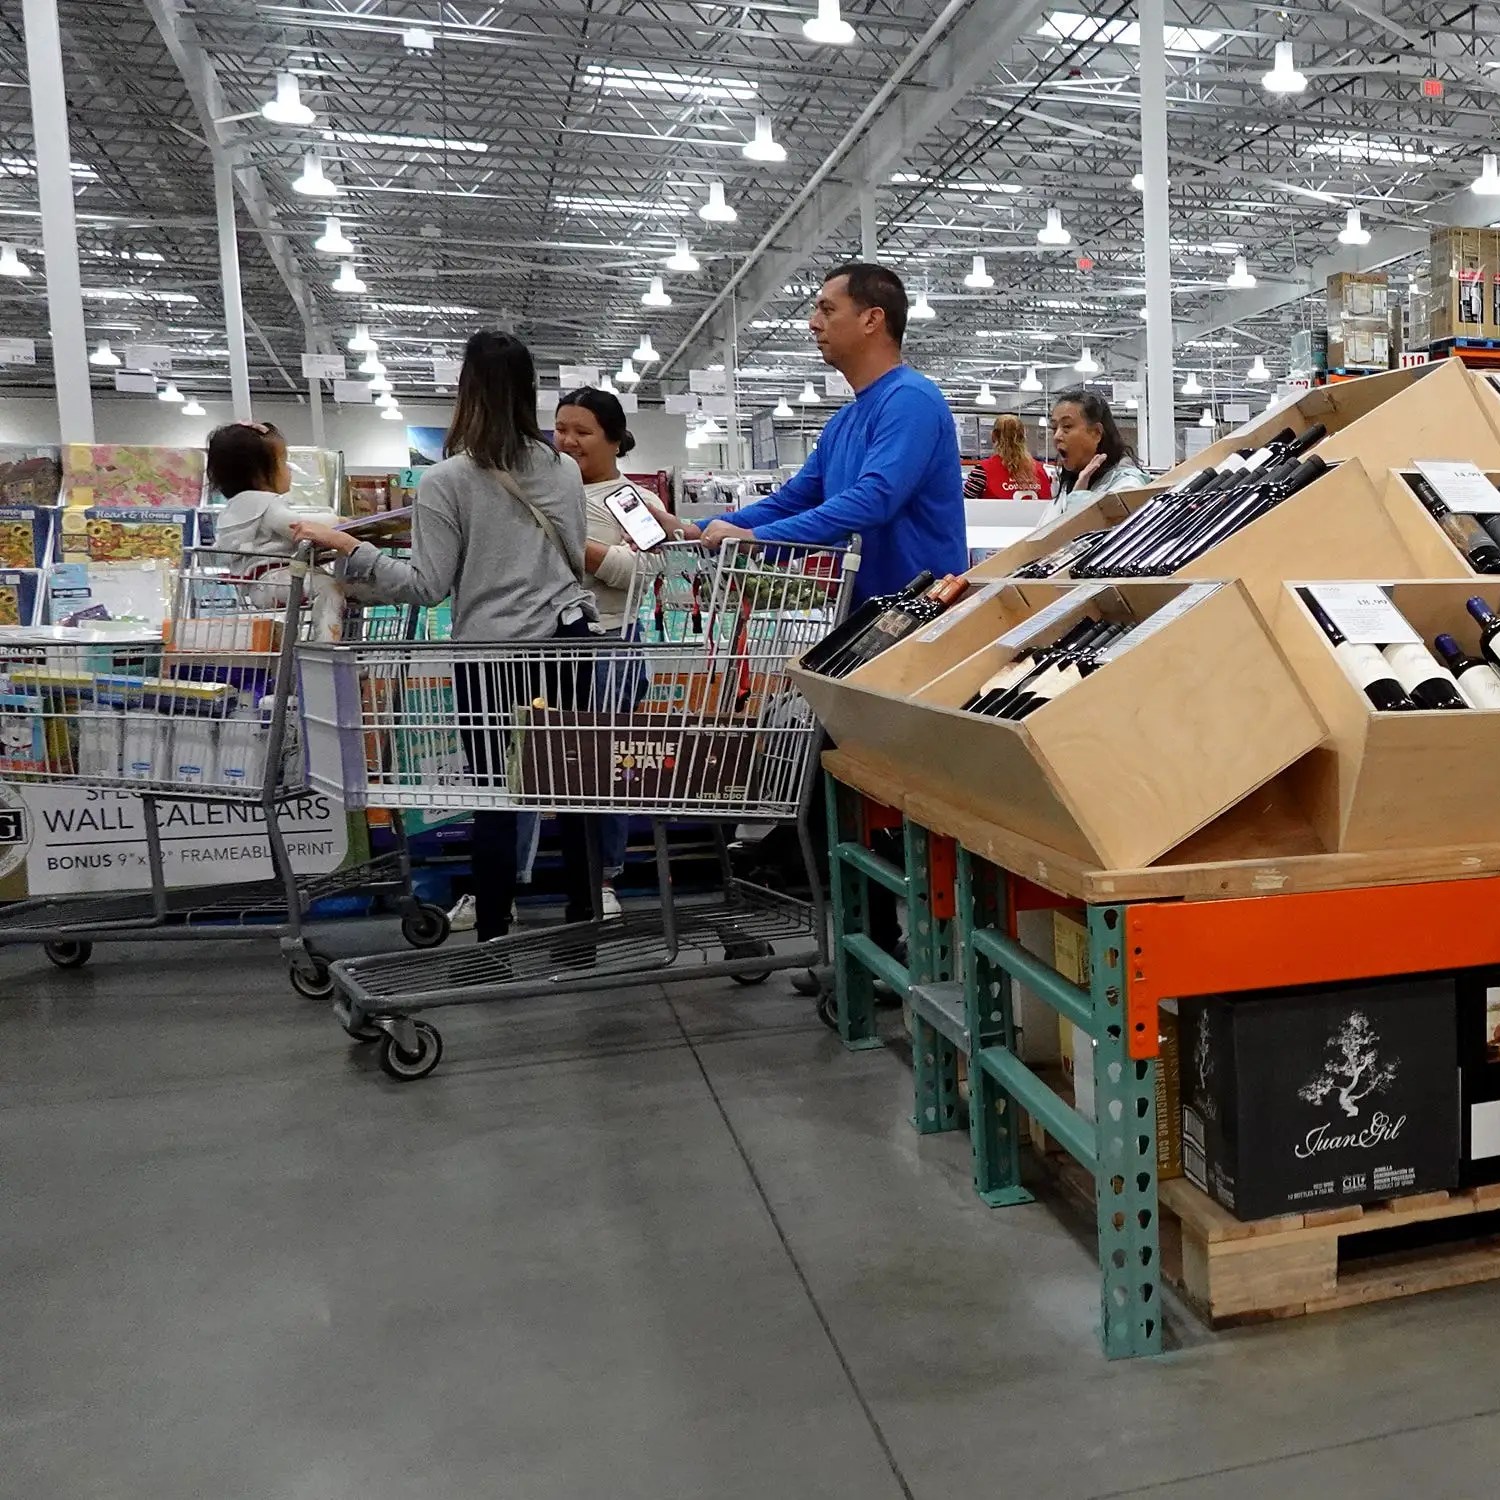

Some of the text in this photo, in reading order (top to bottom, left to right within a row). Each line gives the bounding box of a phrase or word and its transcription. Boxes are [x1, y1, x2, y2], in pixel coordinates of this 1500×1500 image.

[405, 470, 413, 483] 2
[96, 511, 127, 520] Heart
[140, 511, 173, 520] Home
[620, 741, 676, 755] LITTLE
[613, 754, 676, 769] POTATO
[42, 805, 134, 833] WALL
[47, 853, 113, 870] BONUS
[180, 845, 273, 863] FRAMEABL
[286, 841, 335, 858] PRINT
[1295, 1111, 1407, 1159] Juan Gil
